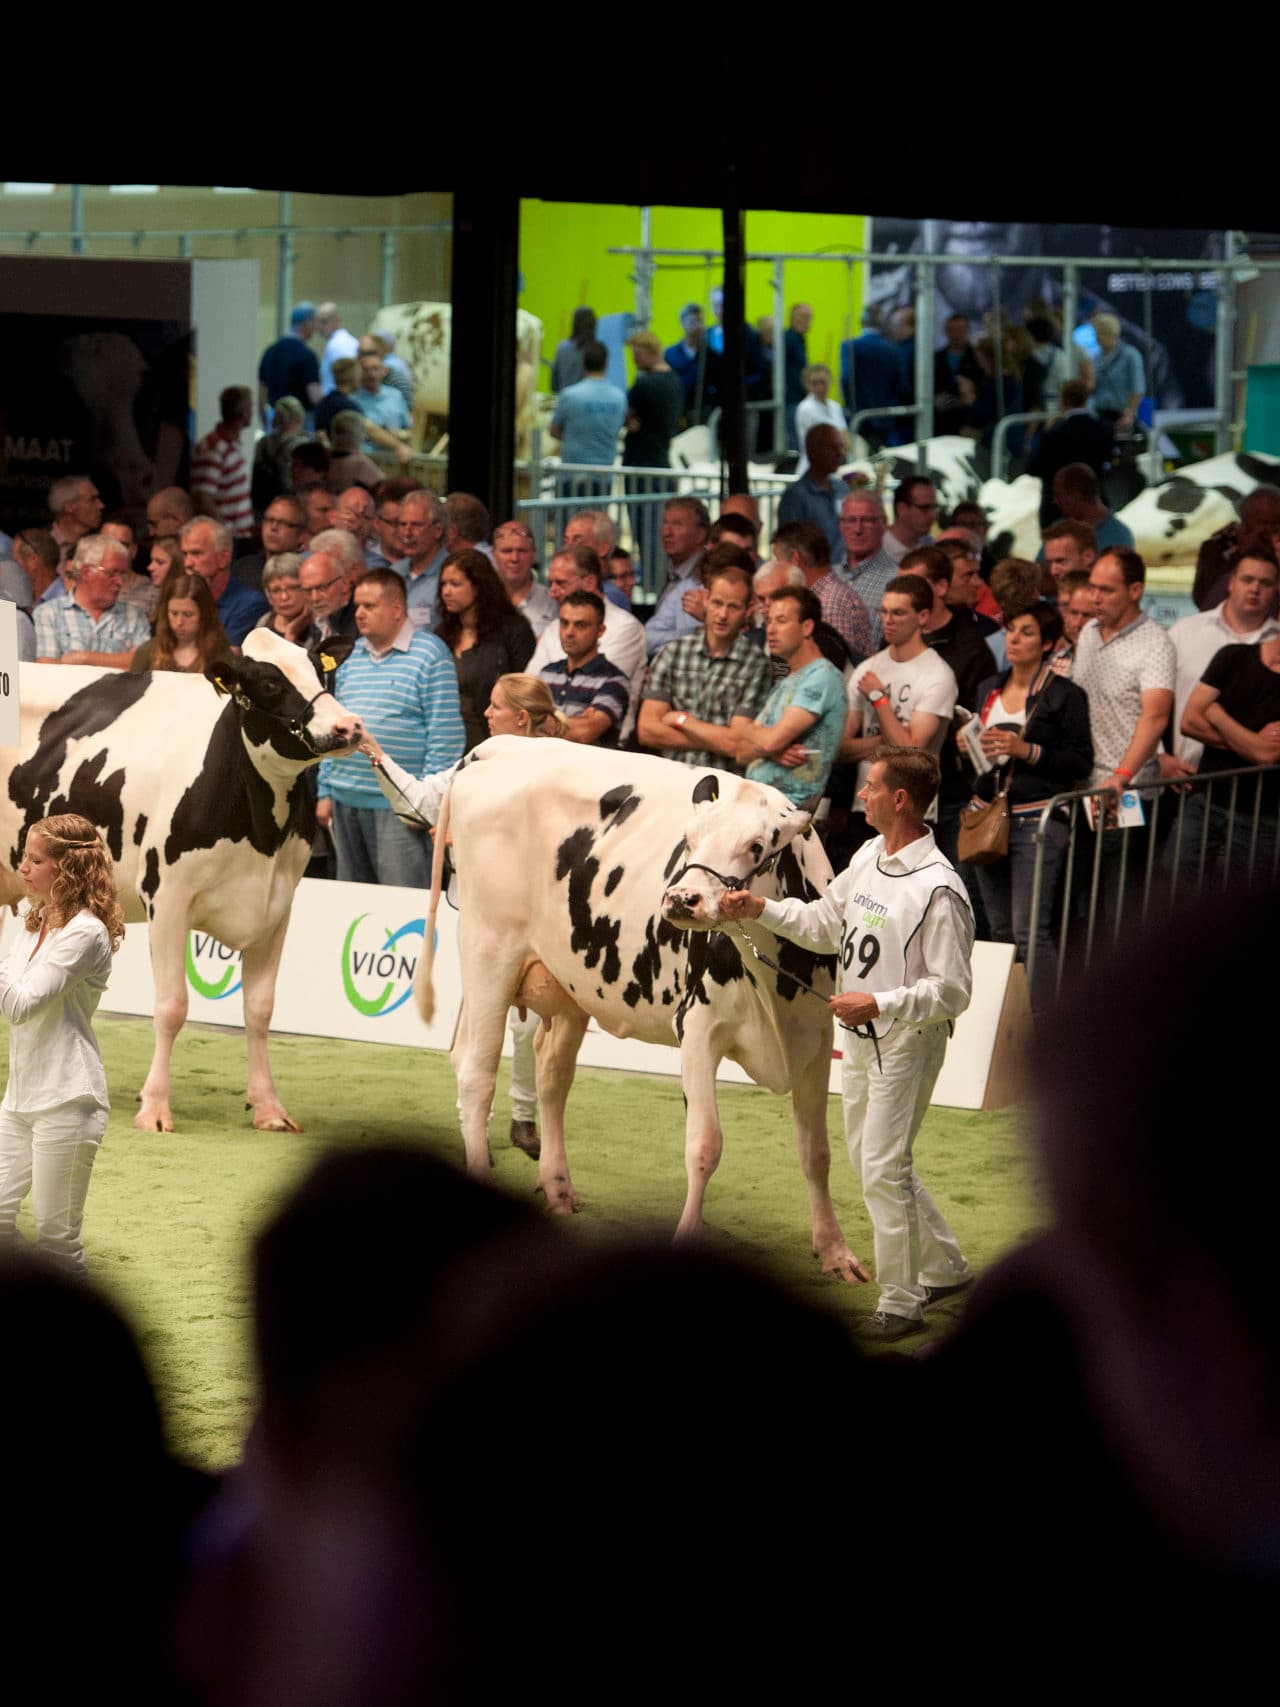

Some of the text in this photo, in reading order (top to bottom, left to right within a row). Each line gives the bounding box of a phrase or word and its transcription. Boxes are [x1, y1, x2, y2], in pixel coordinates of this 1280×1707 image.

[5, 435, 76, 464] MAAT
[853, 892, 888, 917] uniform
[194, 934, 242, 961] VIO
[353, 951, 417, 980] VION
